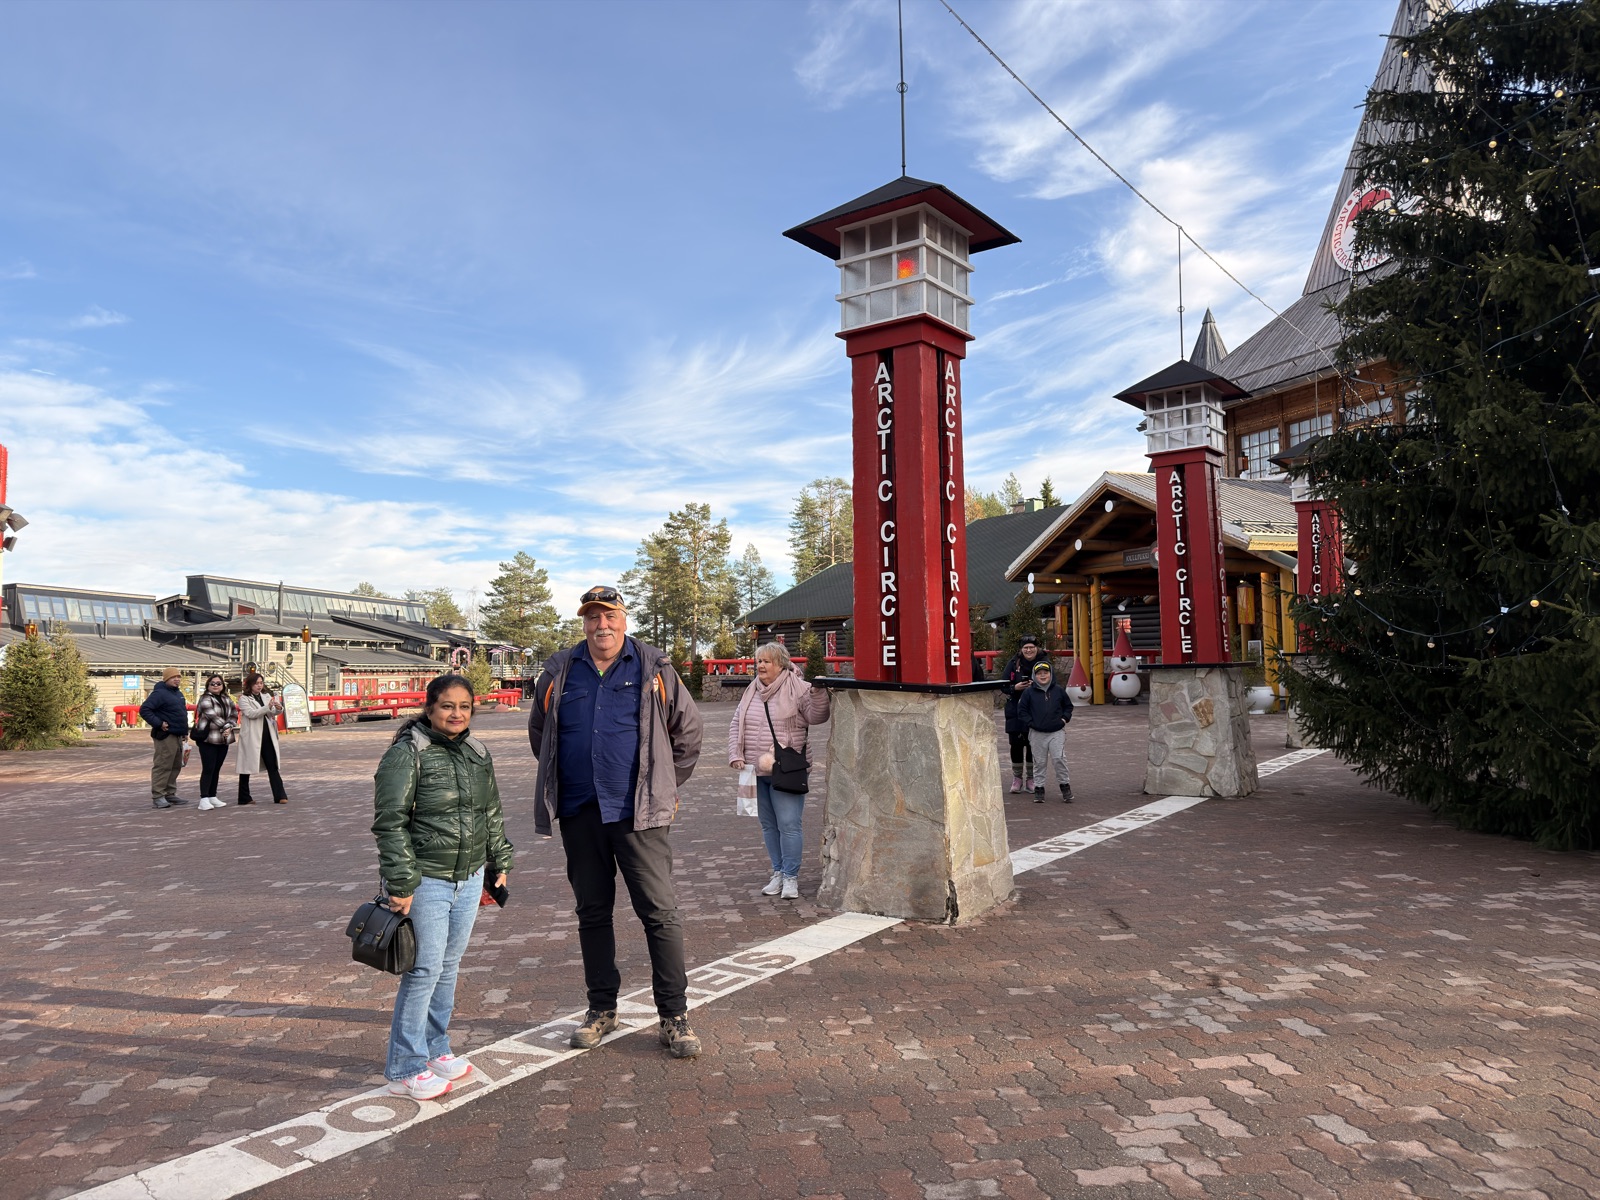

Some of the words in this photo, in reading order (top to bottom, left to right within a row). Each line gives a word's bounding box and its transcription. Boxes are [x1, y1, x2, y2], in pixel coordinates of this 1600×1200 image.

[1333, 208, 1349, 249] ARCTIC
[1335, 248, 1358, 270] CIRCL
[874, 362, 893, 502] ARCTIC
[944, 361, 957, 501] ARCTIC
[1168, 471, 1186, 556] ARCTIC
[1311, 513, 1321, 575] ARCTIC
[880, 520, 897, 666] CIRCLE
[946, 523, 960, 666] CIRCLE
[1176, 568, 1192, 654] CIRCLE
[1219, 568, 1229, 652] CIRCLE
